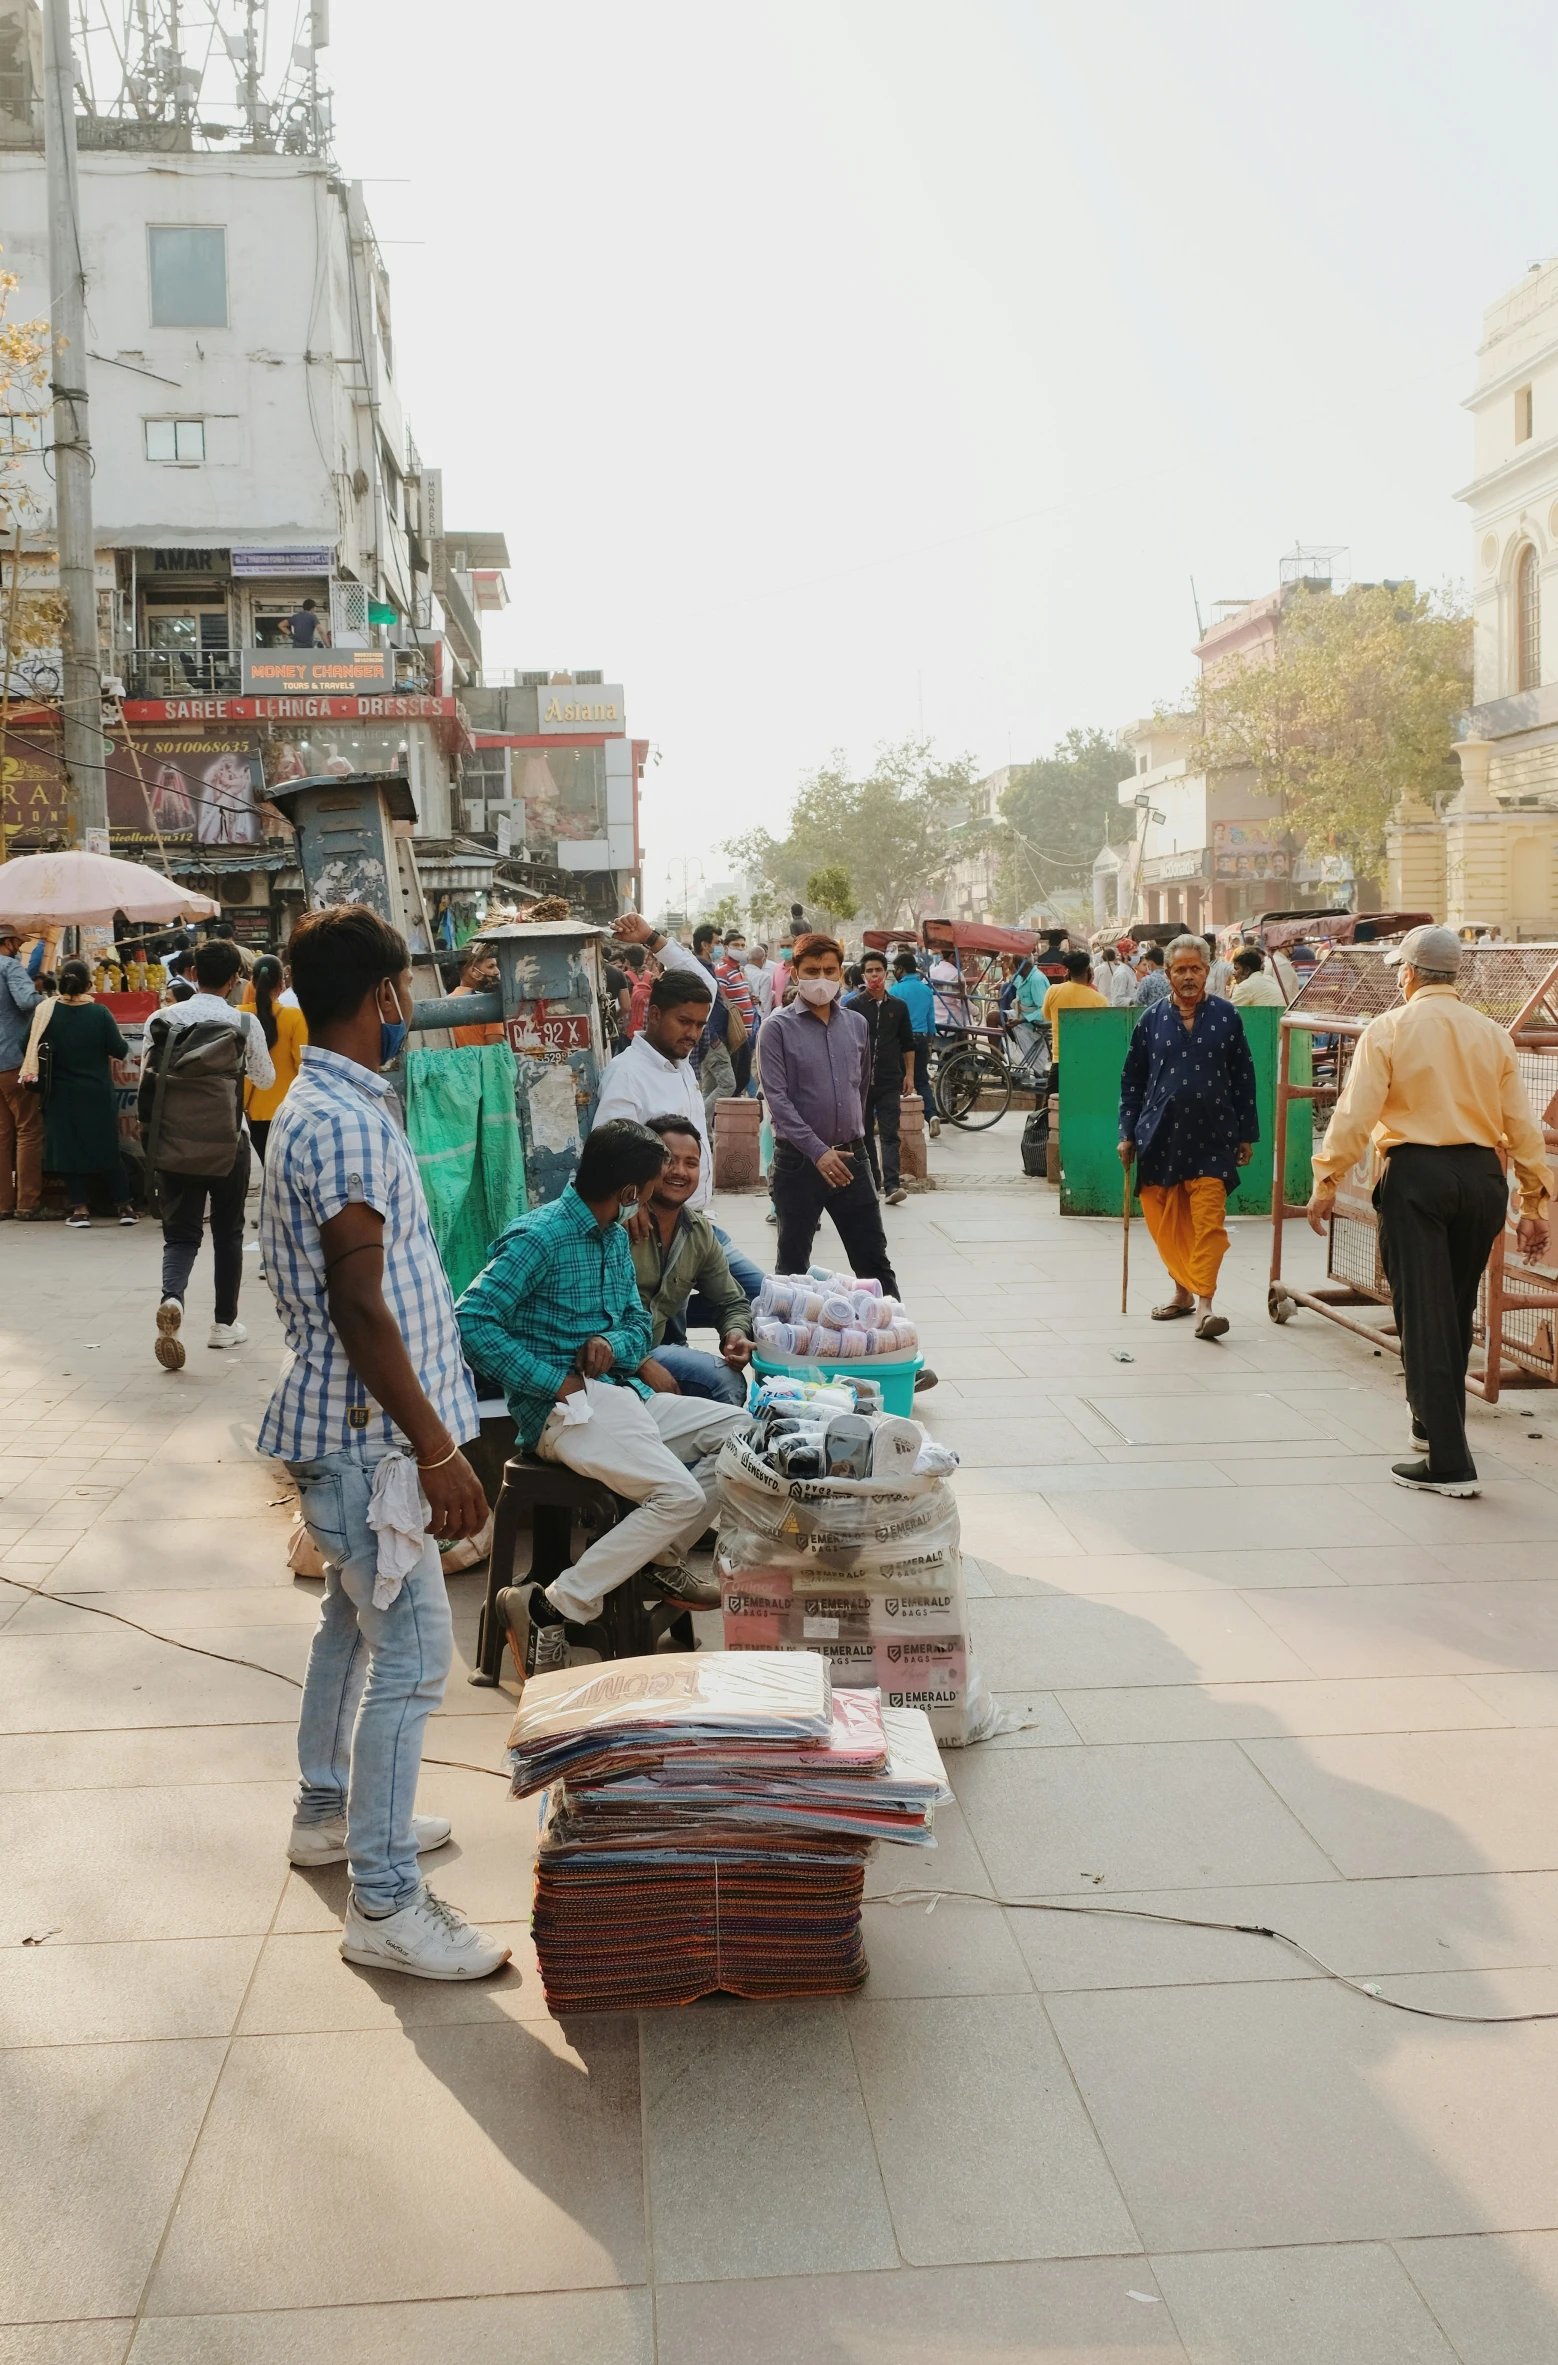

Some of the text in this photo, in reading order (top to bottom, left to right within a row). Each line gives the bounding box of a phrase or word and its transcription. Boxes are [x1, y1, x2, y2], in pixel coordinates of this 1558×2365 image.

[428, 481, 436, 536] MONARCH
[154, 549, 213, 571] AMAR
[251, 664, 385, 679] MONEY CHANGER
[283, 682, 355, 690] TOURS & TRAVELS
[165, 701, 227, 719] SAREE
[357, 698, 443, 717] DRESSES
[544, 696, 618, 722] Asiana
[154, 741, 250, 753] 8010068635
[889, 1511, 932, 1536] EMERALD
[811, 1532, 862, 1545] EMERALD
[811, 1544, 839, 1553] BAGS
[896, 1550, 943, 1570] EMERALD
[744, 1597, 792, 1609] EMERALD
[821, 1598, 871, 1609] EMERALD
[901, 1597, 951, 1608] EMERALD
[743, 1609, 768, 1617] BAGS
[901, 1608, 928, 1617] BAGS
[823, 1645, 873, 1656] EMERALD
[903, 1642, 954, 1655] EMERALD
[527, 1646, 535, 1665] NIKE
[830, 1657, 850, 1665] AGS
[904, 1655, 930, 1664] BAGS
[905, 1691, 956, 1702] EMERALD
